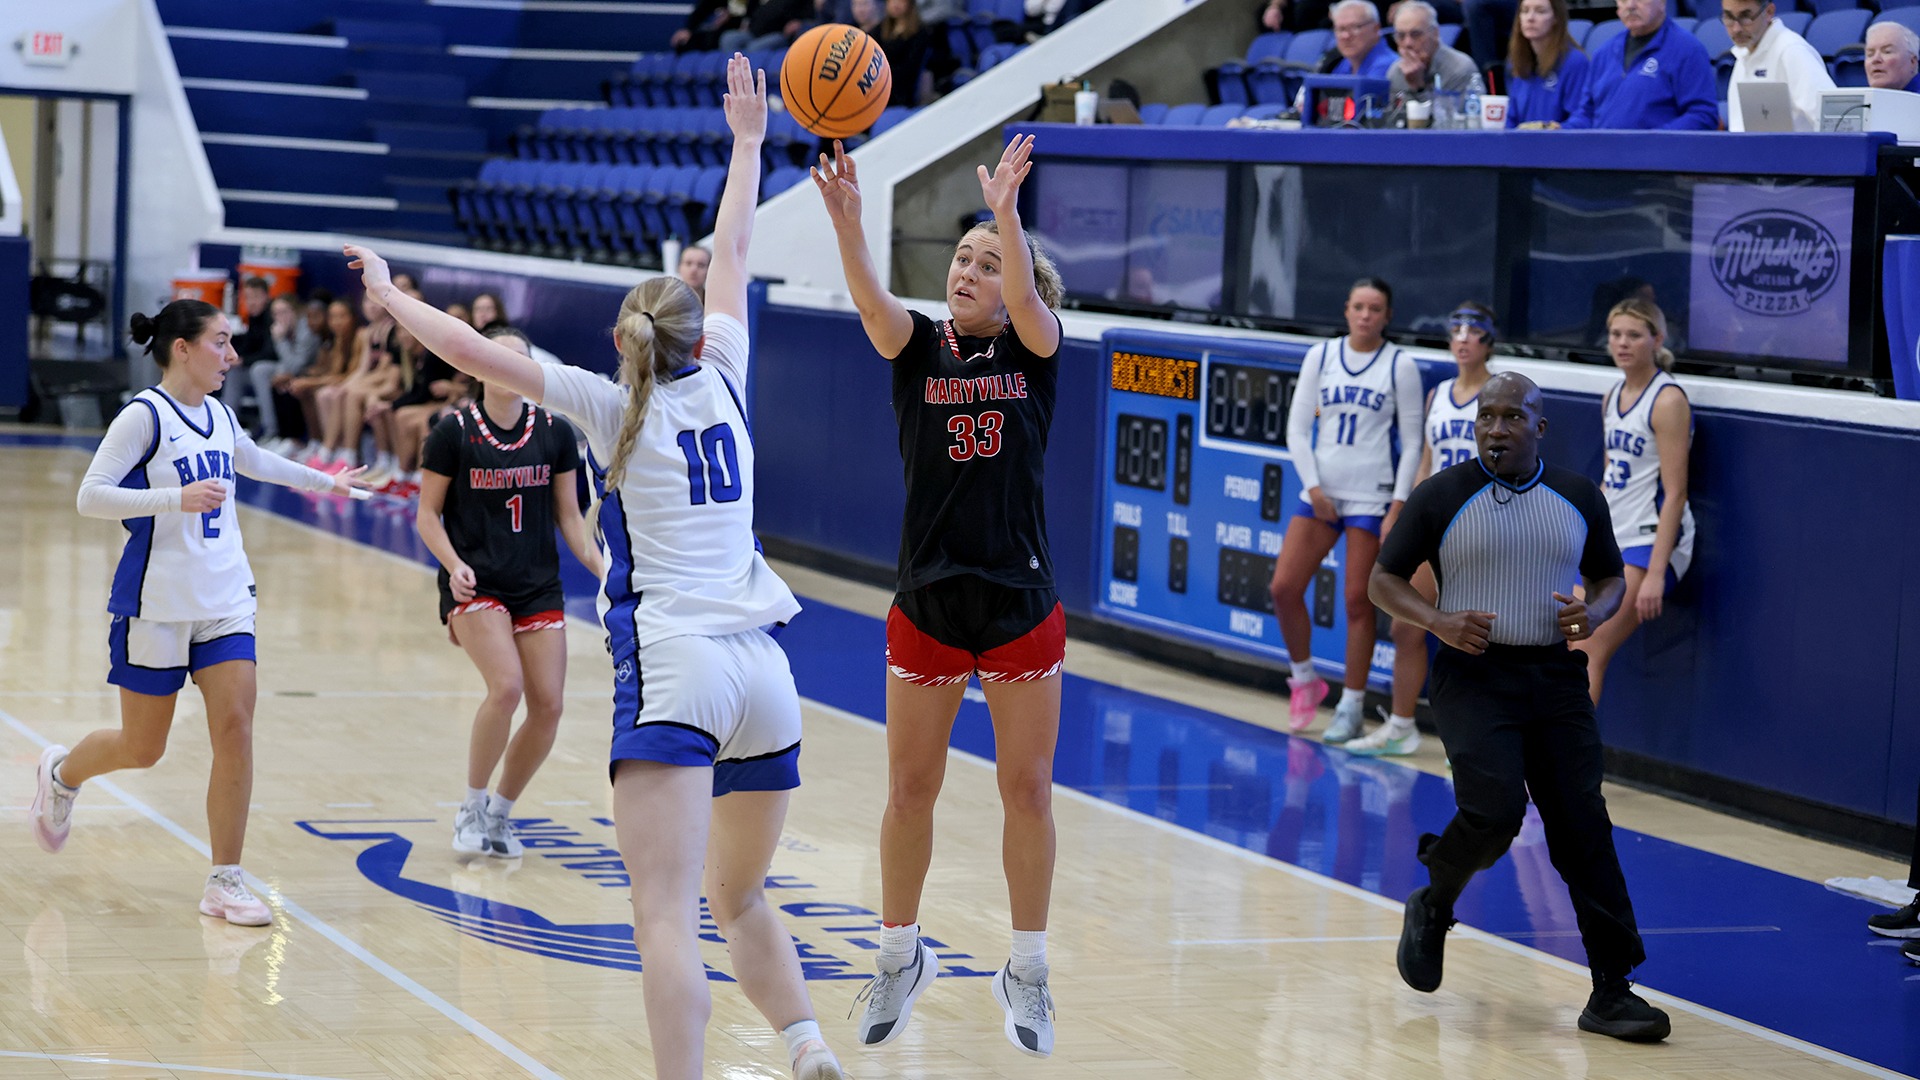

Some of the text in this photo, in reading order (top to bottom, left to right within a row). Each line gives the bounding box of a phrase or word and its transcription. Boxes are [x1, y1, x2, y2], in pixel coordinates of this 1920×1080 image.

[33, 31, 63, 56] EXIT
[819, 29, 859, 82] Wilson
[857, 45, 884, 96] NCAA
[1744, 291, 1801, 311] PIZZA
[925, 372, 1028, 404] MARYVILLE
[1320, 385, 1387, 412] HAWKS
[947, 410, 1004, 462] 33
[1336, 412, 1358, 446] 11
[469, 464, 551, 490] MARYVILLE
[676, 422, 742, 505] 10
[1223, 474, 1261, 502] PERIOD
[505, 493, 522, 533] 1
[1113, 501, 1142, 527] FOULS
[1215, 521, 1252, 549] PLAYER
[1109, 580, 1138, 608] SCORE
[1229, 609, 1263, 638] MATCH
